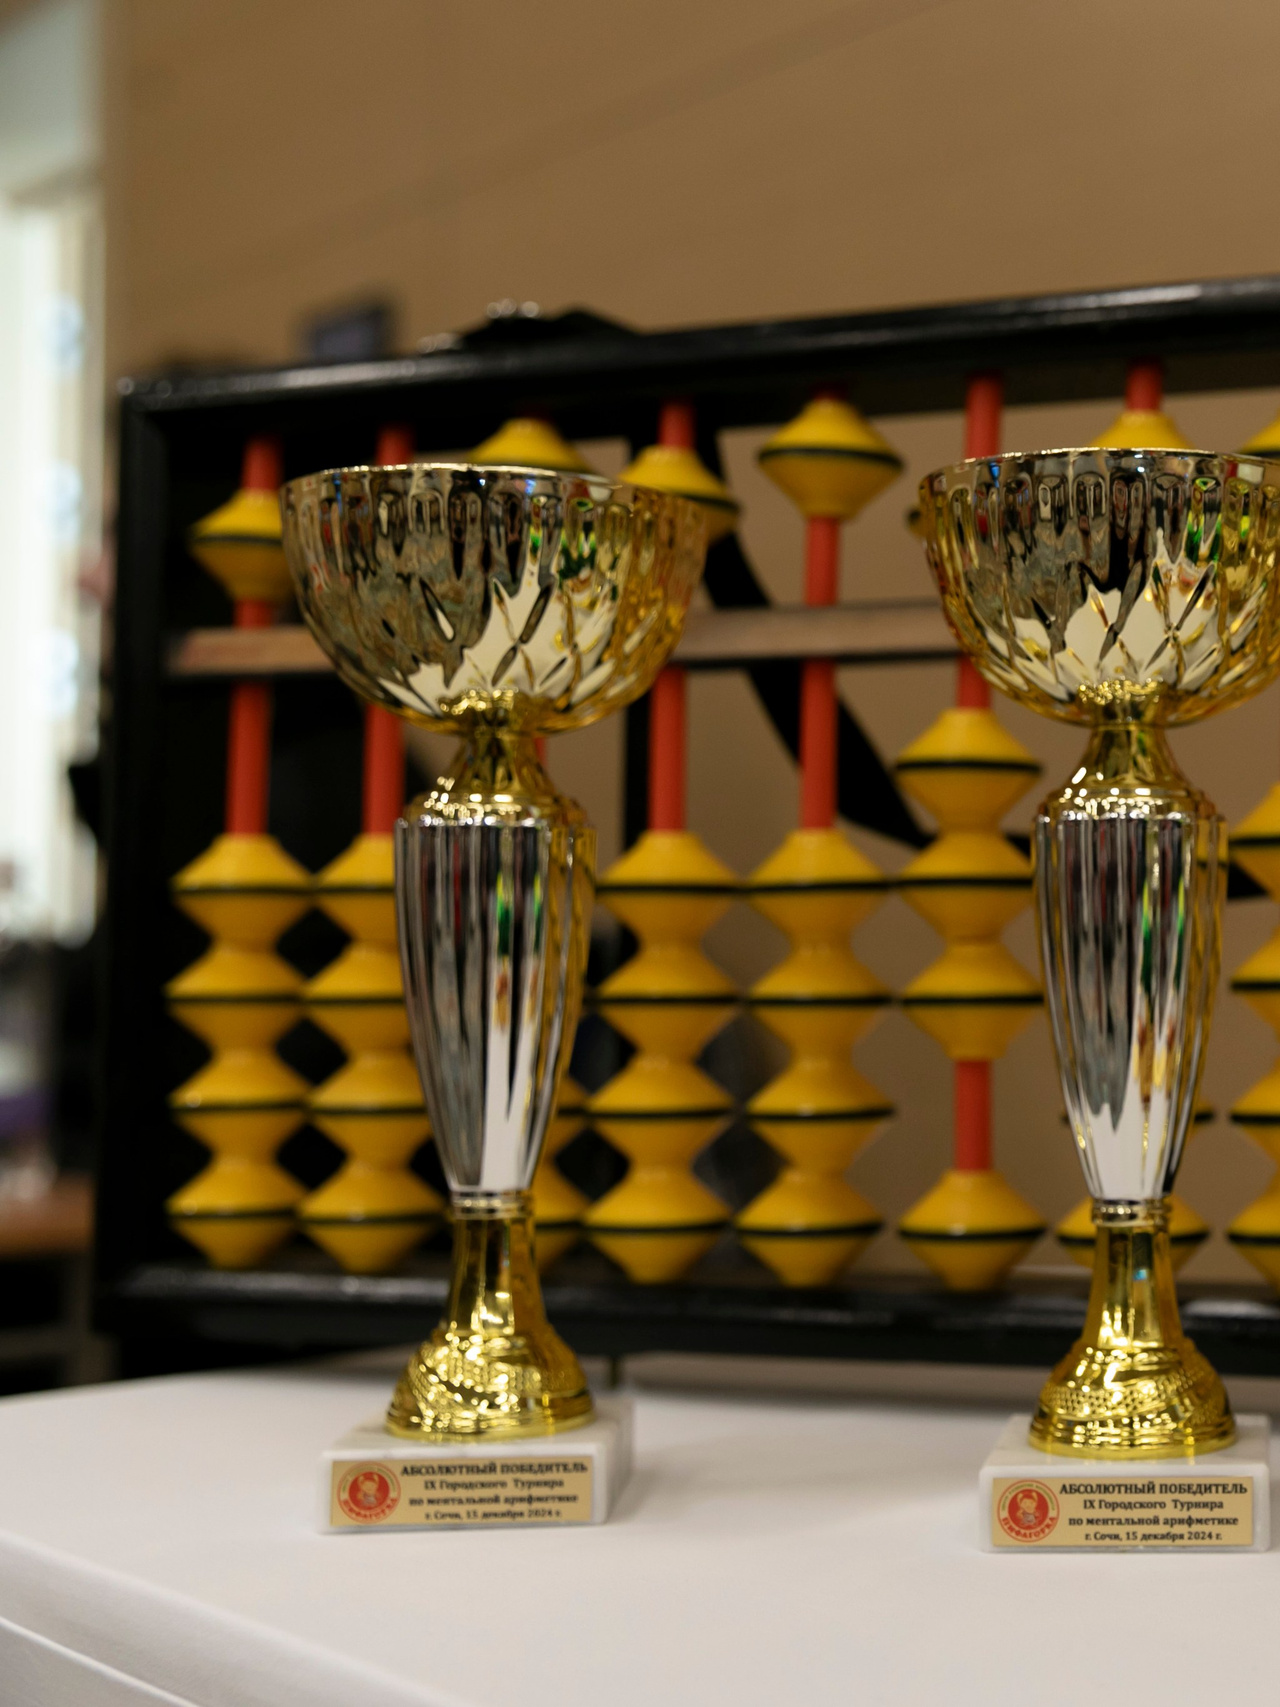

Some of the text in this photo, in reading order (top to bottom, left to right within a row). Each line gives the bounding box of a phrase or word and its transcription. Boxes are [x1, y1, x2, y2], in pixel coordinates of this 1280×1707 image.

[402, 1462, 588, 1476] АБСОЛЮТНЫЙ ПОБЕДИТЕЛЬ
[1060, 1481, 1247, 1495] АБСОЛЮТНЫЙ ПОБЕДИТЕЛЬ
[1083, 1500, 1223, 1511] IX Городского Турнира
[1086, 1515, 1159, 1525] ментальной
[1163, 1516, 1238, 1527] арифметике
[1094, 1532, 1122, 1541] Сочи,
[1126, 1532, 1137, 1540] 15
[1140, 1531, 1184, 1542] декабря
[1187, 1532, 1212, 1540] 2024
